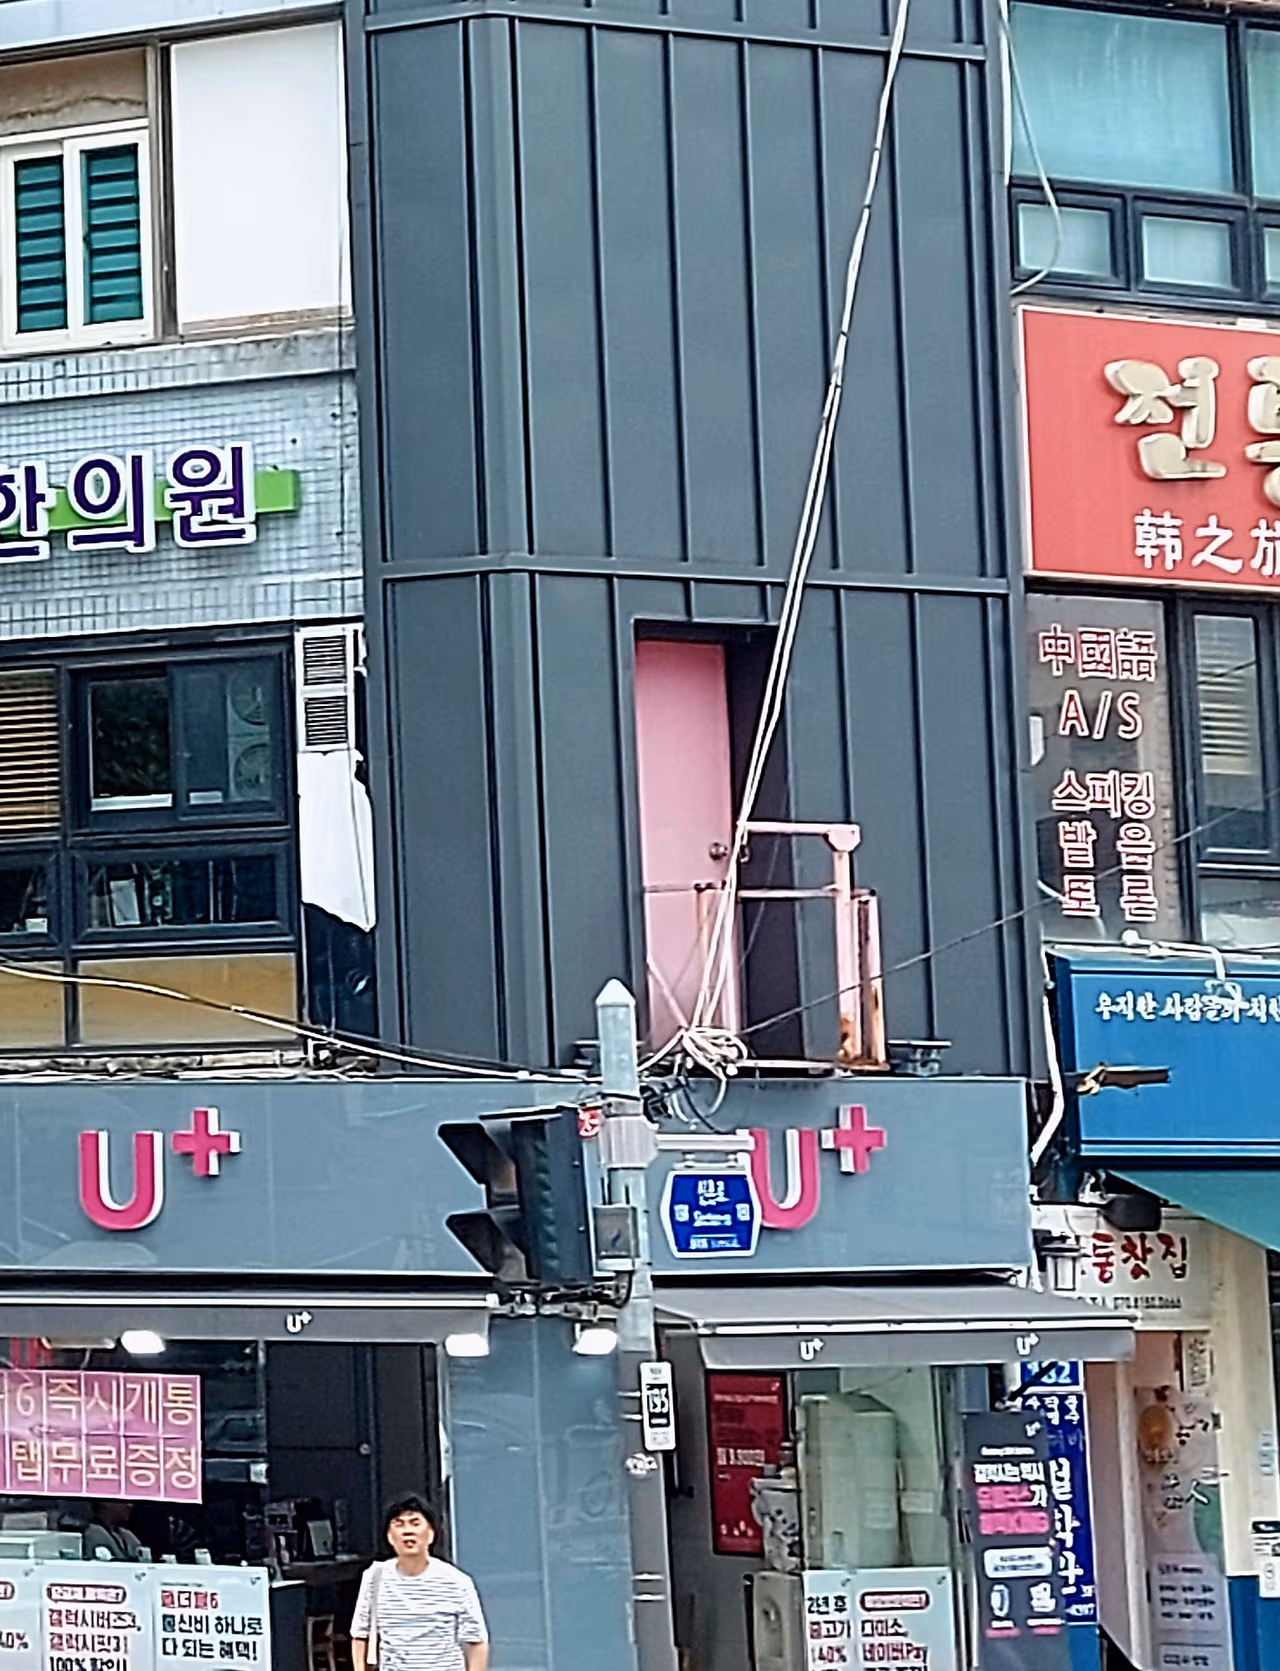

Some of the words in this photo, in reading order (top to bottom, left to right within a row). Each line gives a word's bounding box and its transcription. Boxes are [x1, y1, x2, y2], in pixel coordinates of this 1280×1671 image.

[1039, 624, 1157, 682] 中國語
[1059, 690, 1143, 740] A/S
[1052, 769, 1155, 819] 스피킹
[78, 1106, 242, 1231] U+
[750, 1105, 886, 1230] U+
[162, 1637, 179, 1656] 다
[214, 1615, 264, 1636] 하나로
